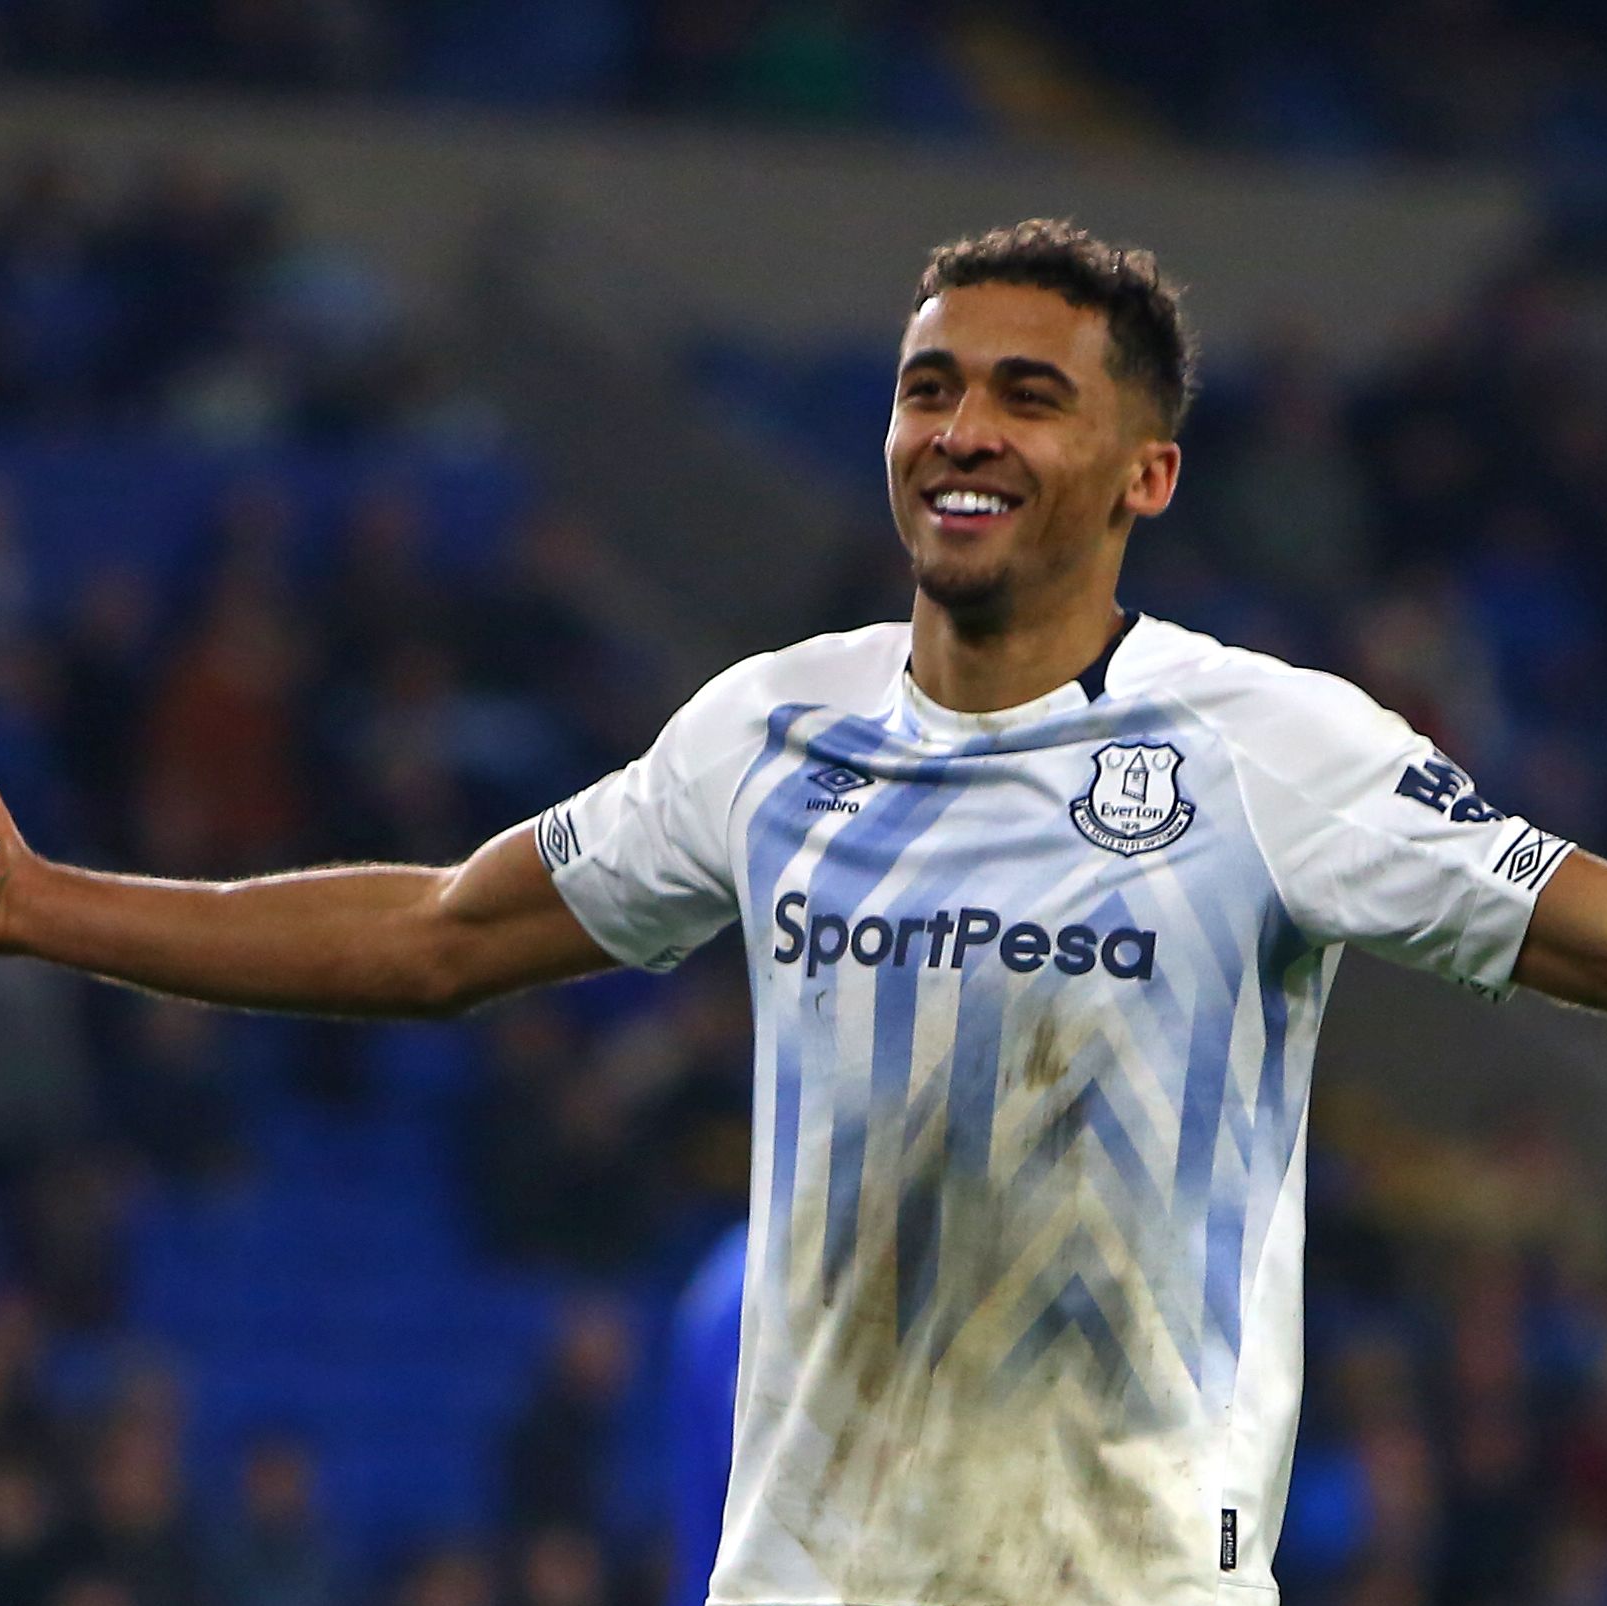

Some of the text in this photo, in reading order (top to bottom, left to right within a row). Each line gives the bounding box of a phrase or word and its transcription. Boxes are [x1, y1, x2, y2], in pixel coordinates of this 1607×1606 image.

[806, 795, 860, 813] umbro
[1100, 801, 1164, 819] Everton
[774, 889, 1157, 981] SportPesa
